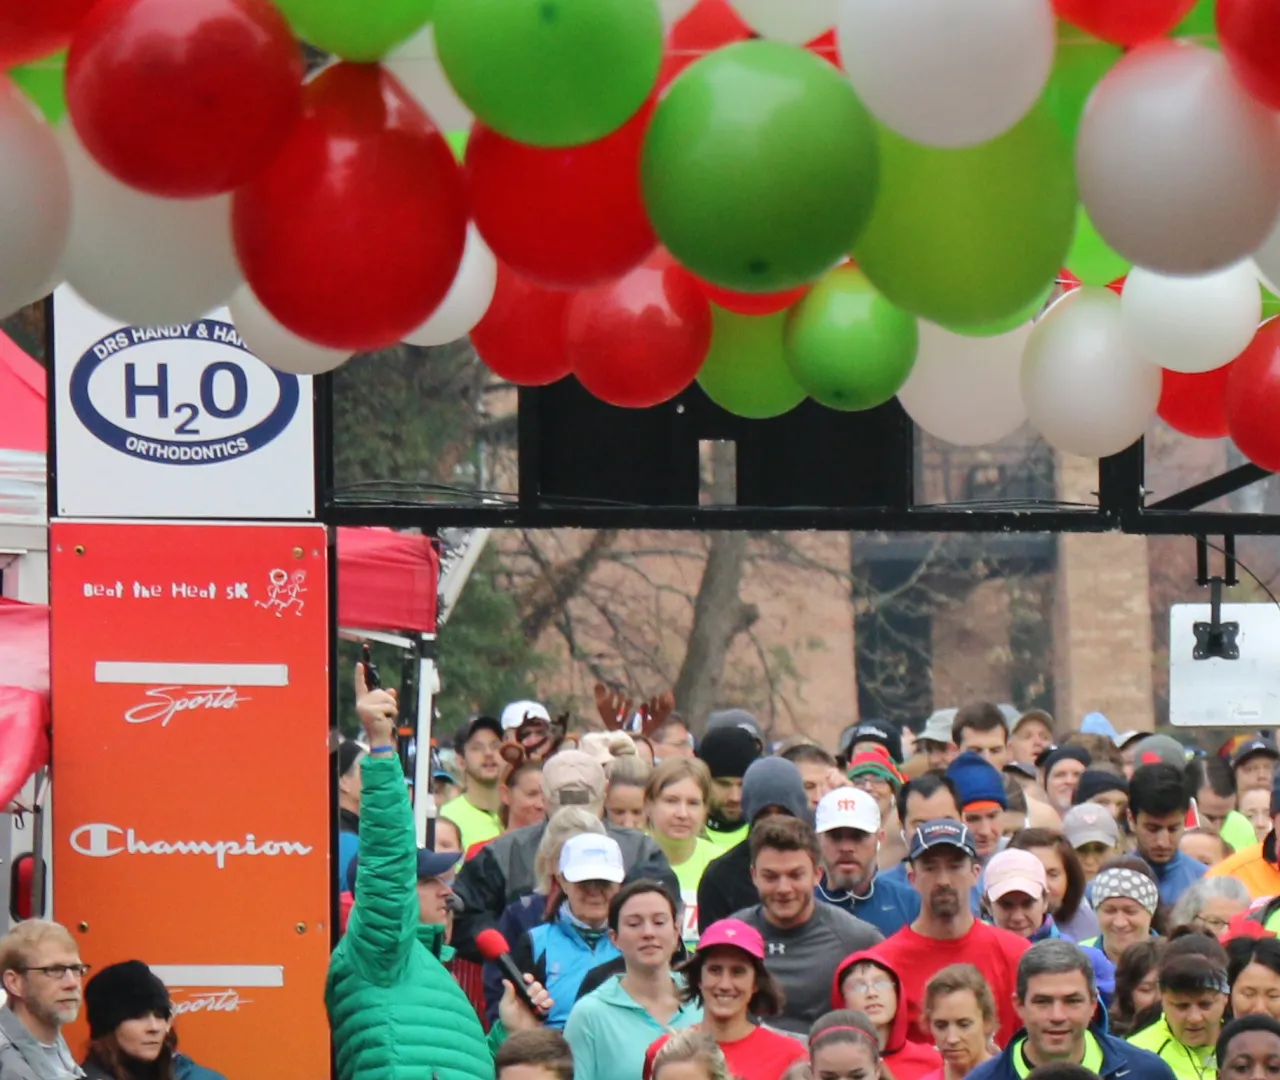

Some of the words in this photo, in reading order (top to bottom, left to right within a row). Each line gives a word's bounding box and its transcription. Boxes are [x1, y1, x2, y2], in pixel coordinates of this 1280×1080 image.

[93, 333, 130, 360] DRS
[131, 324, 192, 341] HANDY
[196, 323, 210, 339] &
[124, 361, 249, 435] H2O
[125, 437, 249, 461] ORTHODONTICS
[82, 582, 124, 598] Beat
[133, 582, 162, 598] the
[171, 582, 215, 599] Heat
[124, 686, 252, 727] Sports
[69, 822, 312, 869] Champion
